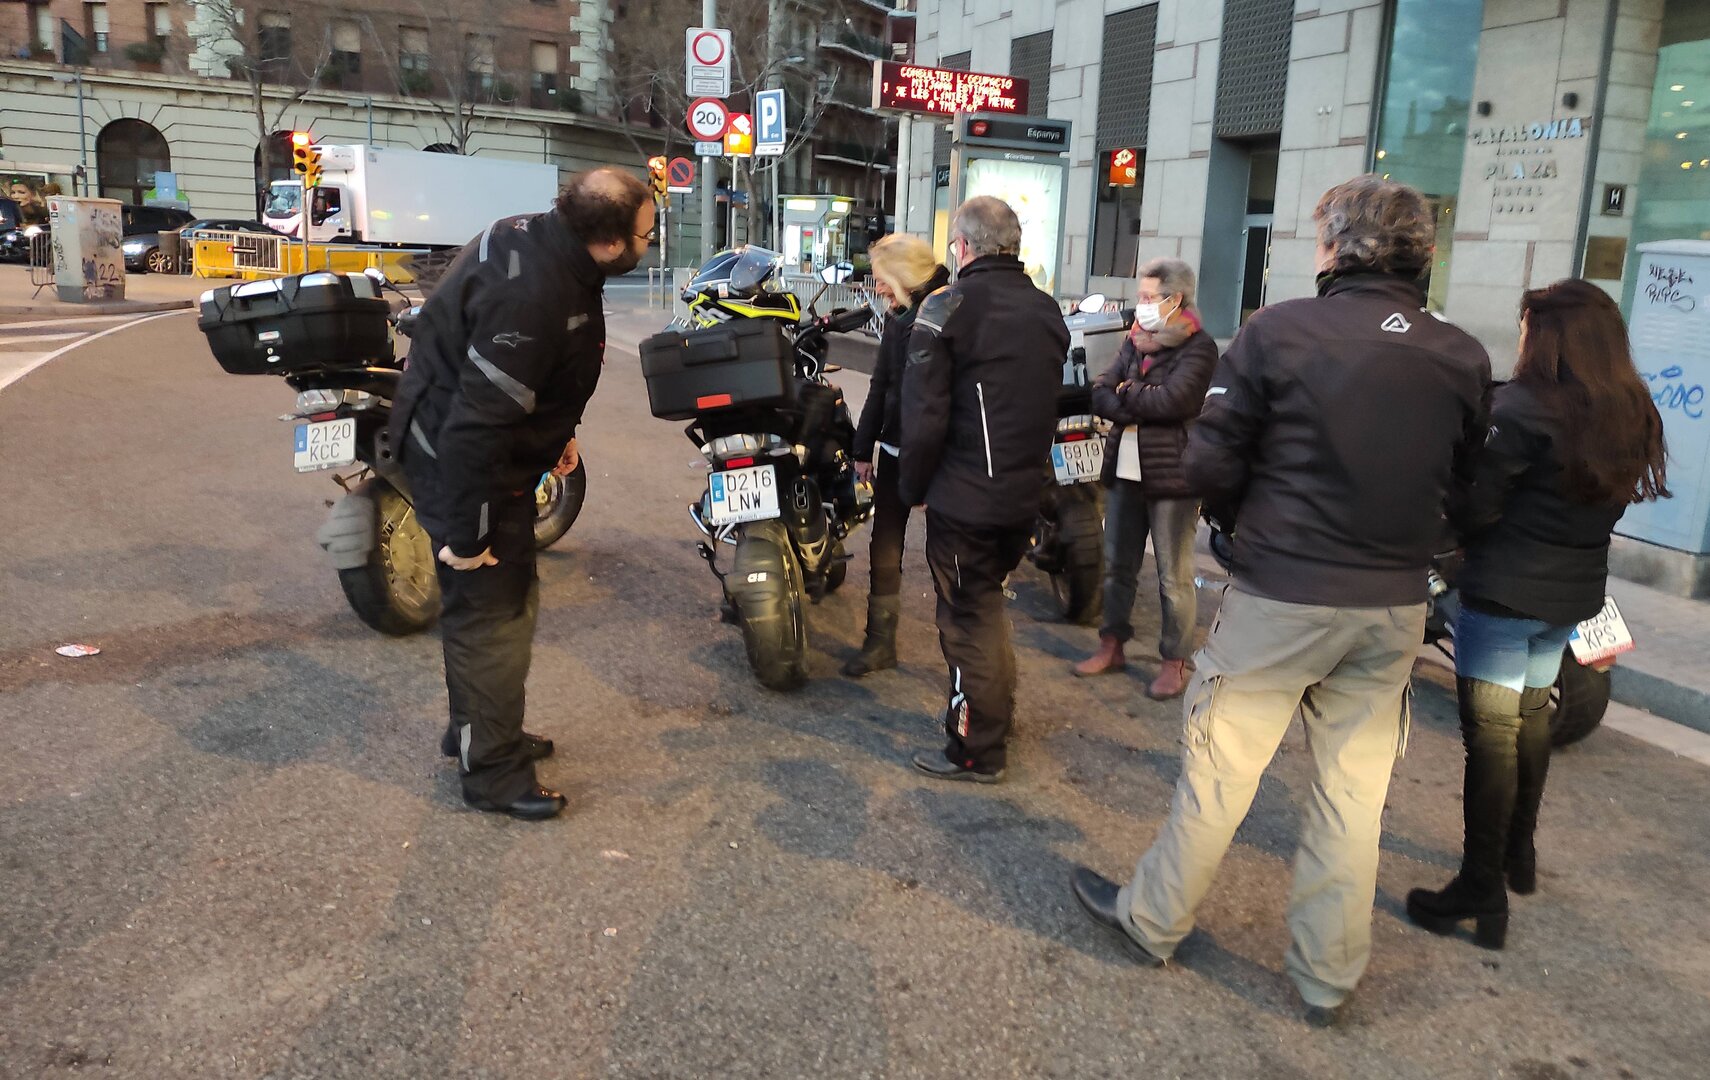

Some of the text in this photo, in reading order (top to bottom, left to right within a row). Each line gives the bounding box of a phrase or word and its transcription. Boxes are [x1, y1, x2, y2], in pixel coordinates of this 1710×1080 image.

[696, 111, 722, 126] 20t
[761, 97, 778, 139] P
[1027, 127, 1060, 140] Espanya
[1485, 159, 1558, 181] PLAZA
[1611, 188, 1621, 205] H
[311, 422, 351, 444] 2120
[309, 442, 340, 462] KCC
[1063, 442, 1100, 460] 6919
[1067, 459, 1094, 476] LNJ
[726, 469, 772, 492] 0216
[728, 490, 761, 512] LNW
[1583, 624, 1617, 650] KPS
